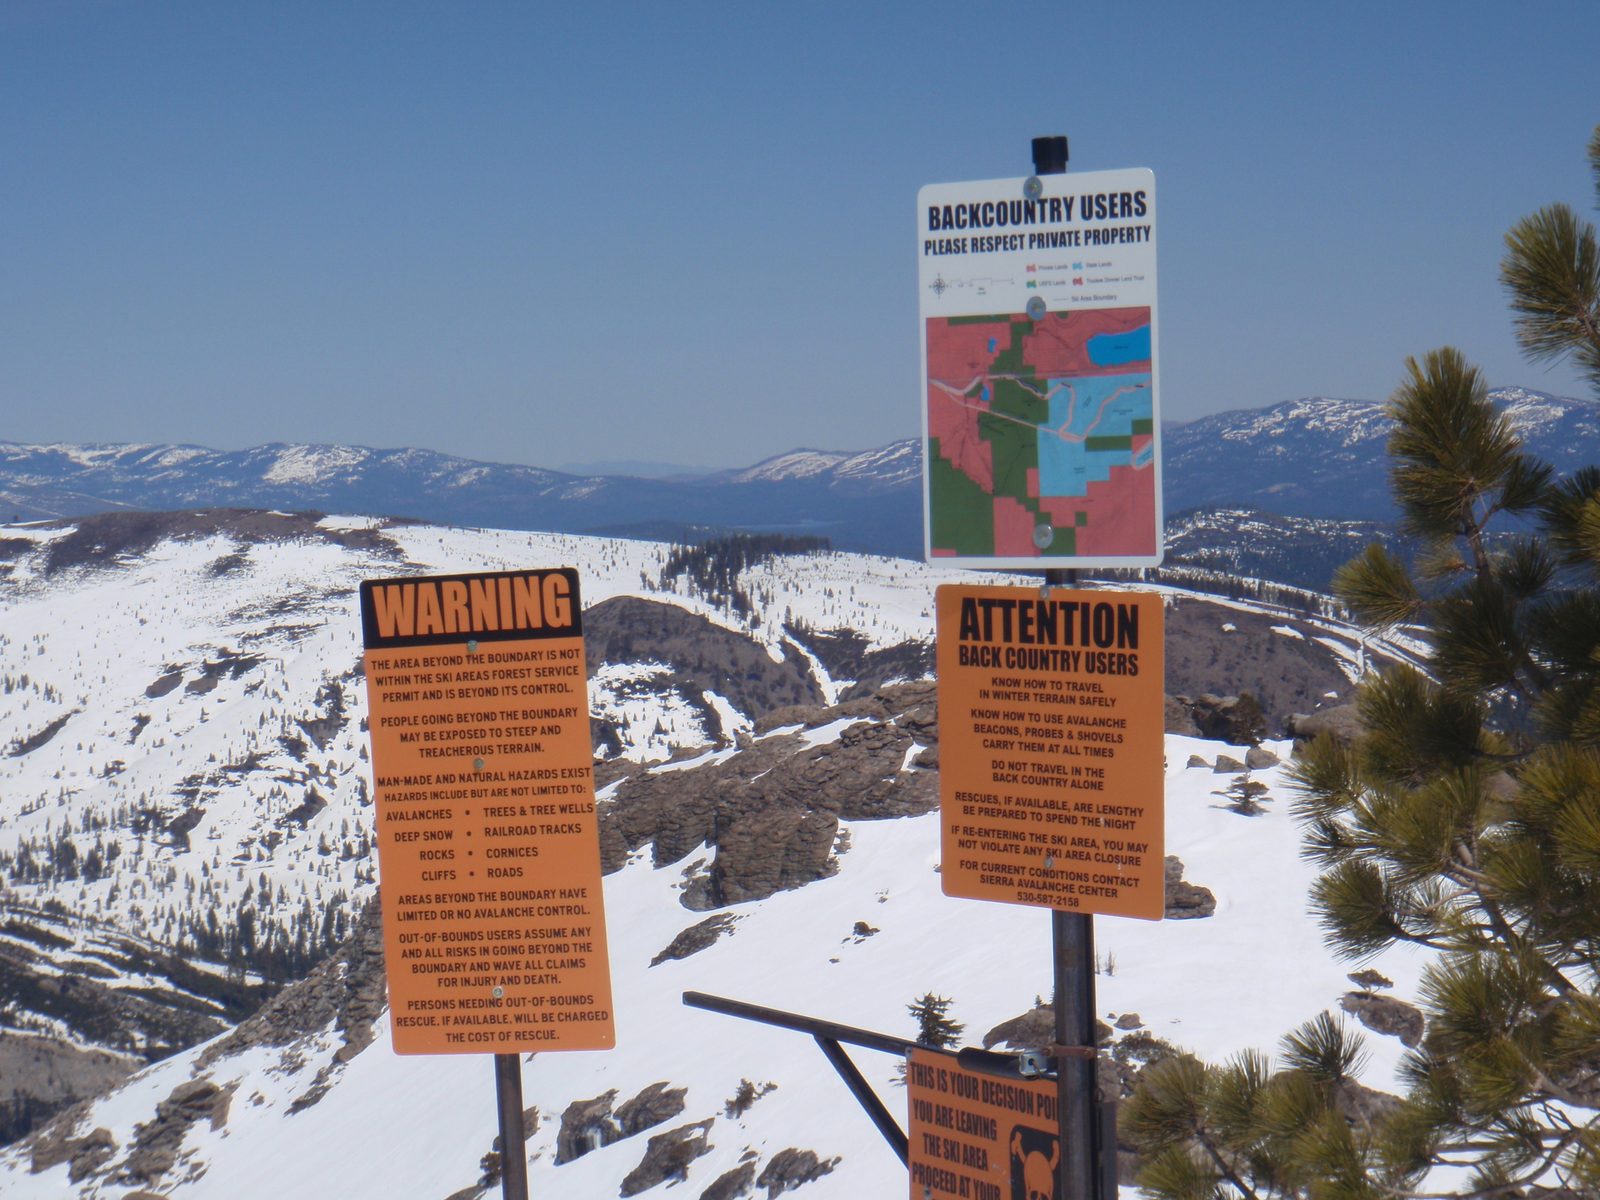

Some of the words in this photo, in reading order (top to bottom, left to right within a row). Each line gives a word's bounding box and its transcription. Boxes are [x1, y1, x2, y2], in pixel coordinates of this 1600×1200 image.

[928, 197, 1074, 231] BACKCOUNTRY
[1080, 190, 1147, 220] USERS
[925, 238, 968, 256] PLEASE
[971, 234, 1025, 252] RESPECT
[1029, 230, 1080, 249] PRIVATE
[1084, 225, 1151, 245] PROPERTY
[373, 574, 571, 636] WARNING
[959, 597, 1138, 650] ATTENTION
[371, 660, 390, 670] THE
[393, 658, 420, 669] AREA
[423, 655, 463, 668] BEYOND
[465, 653, 485, 664] THE
[488, 651, 543, 664] BOUNDARY
[546, 650, 557, 660] IS
[559, 648, 580, 659] NOT
[959, 645, 1002, 668] BACK
[1005, 647, 1081, 672] COUNTRY
[1085, 651, 1138, 676] USERS
[375, 675, 411, 686] WITHIN
[414, 674, 433, 684] THE
[435, 673, 452, 683] SKI
[455, 670, 490, 682] AREAS
[492, 668, 532, 680] FOREST
[534, 665, 579, 678] SERVICE
[382, 691, 420, 702] PERMIT
[422, 690, 443, 701] AND
[445, 689, 456, 699] IS
[458, 686, 499, 699] BEYOND
[501, 685, 518, 696] ITS
[991, 677, 1021, 688] KNOW
[1024, 679, 1047, 689] HOW
[1049, 680, 1063, 691] TO
[1065, 681, 1104, 693] TRAVEL
[979, 689, 990, 699] IN
[992, 690, 1030, 702] WINTER
[1033, 693, 1076, 705] TERRAIN
[1079, 695, 1116, 707] SAFELY
[381, 715, 419, 727] PEOPLE
[421, 714, 454, 725] GOING
[456, 711, 497, 723] BEYOND
[499, 710, 519, 720] THE
[522, 707, 578, 720] BOUNDARY
[971, 708, 1000, 720] KNOW
[1003, 711, 1025, 721] HOW
[1028, 712, 1041, 723] TO
[1044, 714, 1063, 724] USE
[1066, 715, 1126, 729] AVALANCHE
[1025, 727, 1064, 739] PROBES
[1066, 730, 1074, 740] &
[1077, 731, 1123, 744] SHOVELS
[418, 744, 494, 758] TREACHEROUS
[982, 739, 1015, 750] CARRY
[1017, 741, 1045, 753] THEM
[1048, 743, 1060, 754] AT
[1062, 745, 1081, 756] ALL
[1083, 746, 1114, 758] TIMES
[377, 775, 432, 787] MAN-MADE
[435, 774, 456, 784] AND
[458, 771, 506, 783] NATURAL
[508, 769, 558, 781] HAZARDS
[561, 767, 591, 779] EXIST
[991, 760, 1005, 770] DO
[1008, 761, 1028, 772] NOT
[1030, 762, 1069, 775] TRAVEL
[1071, 766, 1082, 776] IN
[1084, 767, 1105, 779] THE
[992, 772, 1019, 784] BACK
[1021, 774, 1068, 788] COUNTRY
[1070, 779, 1104, 791] ALONE
[386, 809, 452, 821] AVALANCHES
[483, 806, 516, 817] TREES
[519, 806, 527, 816] &
[530, 804, 556, 815] TREE
[558, 803, 594, 814] WELLS
[963, 805, 975, 816] BE
[977, 806, 1027, 820] PREPARED
[1030, 811, 1043, 822] TO
[1045, 813, 1078, 825] SPEND
[1081, 816, 1101, 827] THE
[1104, 818, 1136, 830] NIGHT
[394, 831, 420, 842] DEEP
[422, 830, 453, 841] SNOW
[484, 825, 537, 837] RAILROAD
[539, 823, 582, 835] TRACKS
[419, 849, 455, 861] ROCKS
[486, 846, 539, 859] CORNICES
[421, 870, 456, 881] CLIFFS
[487, 867, 524, 878] ROADS
[960, 860, 979, 871] FOR
[981, 862, 1026, 875] CURRENT
[1029, 867, 1089, 883] CONDITIONS
[1092, 874, 1140, 887] CONTACT
[980, 874, 1015, 887] SIERRA
[1017, 878, 1075, 894] AVALANCHE
[1078, 885, 1118, 898] CENTER
[398, 894, 432, 905] AREAS
[434, 892, 476, 904] BEYOND
[477, 891, 497, 902] THE
[500, 889, 556, 901] BOUNDARY
[559, 888, 587, 899] HAVE
[1017, 891, 1080, 908] 530-587-2158
[397, 910, 437, 922] LIMITED
[440, 910, 454, 920] OR
[457, 909, 471, 919] NO
[474, 906, 535, 919] AVALANCHE
[399, 931, 484, 944] OUT-OF-BOUNDS
[486, 929, 522, 941] USERS
[524, 928, 568, 939] ASSUME
[570, 927, 591, 937] ANY
[412, 962, 467, 974] BOUNDARY
[469, 961, 490, 972] AND
[493, 960, 522, 971] WAVE
[524, 960, 544, 970] ALL
[546, 958, 586, 970] CLAIMS
[437, 977, 458, 988] FOR
[460, 976, 497, 987] INJURY
[499, 975, 521, 986] AND
[408, 999, 456, 1011] PERSONS
[458, 997, 503, 1009] NEEDING
[506, 995, 594, 1008] OUT-OF-BOUNDS
[445, 1032, 466, 1043] THE
[467, 1031, 496, 1042] COST
[498, 1031, 512, 1042] OF
[910, 1062, 934, 1090] THIS
[937, 1069, 948, 1092] IS
[950, 1072, 979, 1101] YOUR
[982, 1079, 1033, 1116] DECISION
[1037, 1093, 1057, 1120] POI
[913, 1098, 932, 1124] YOU
[935, 1104, 953, 1129] ARE
[956, 1109, 997, 1141] LEAVING
[923, 1133, 941, 1157] THE
[944, 1138, 960, 1163] SKI
[962, 1143, 988, 1171] AREA
[912, 1162, 956, 1194] PROCEED
[960, 1175, 970, 1198] AT
